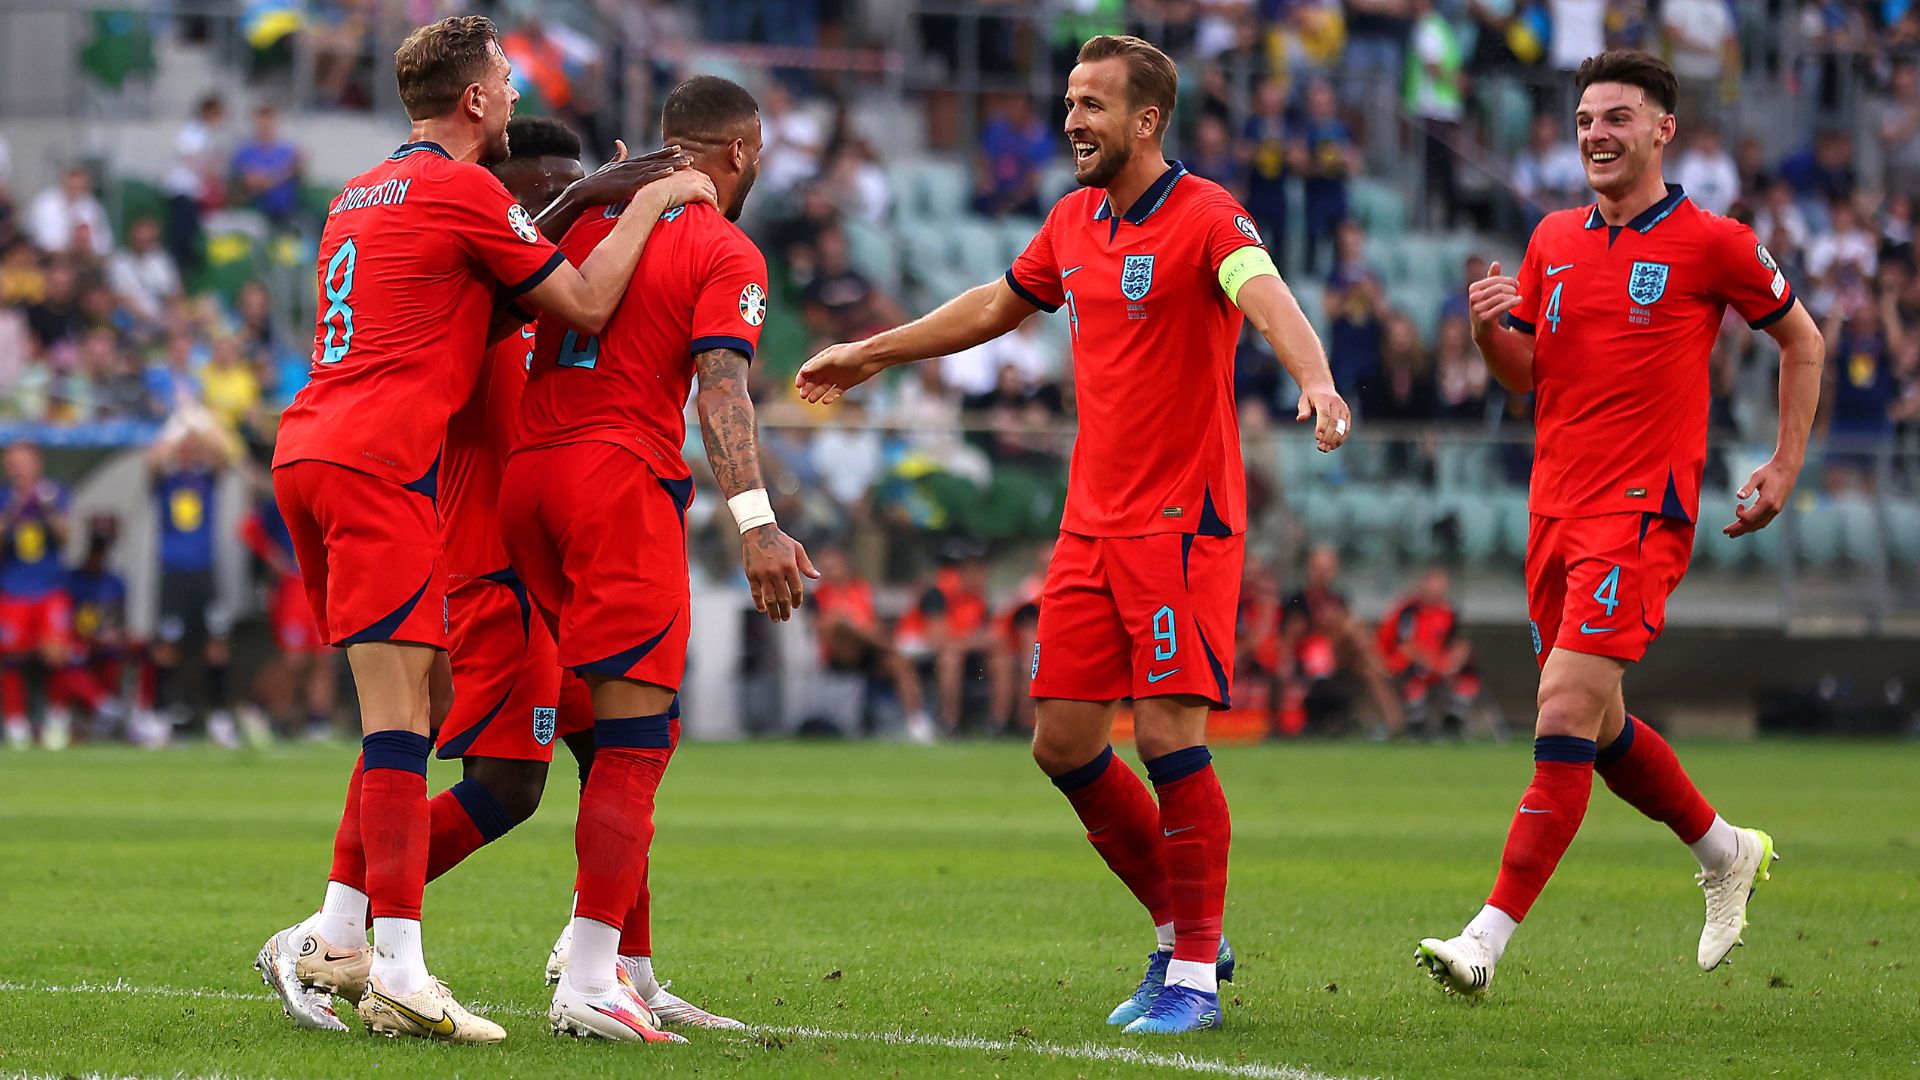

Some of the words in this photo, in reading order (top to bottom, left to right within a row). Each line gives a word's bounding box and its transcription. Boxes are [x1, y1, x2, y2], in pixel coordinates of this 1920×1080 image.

[320, 237, 357, 363] 8
[1545, 281, 1564, 333] 4
[1593, 565, 1620, 616] 4
[1153, 605, 1177, 661] 9
